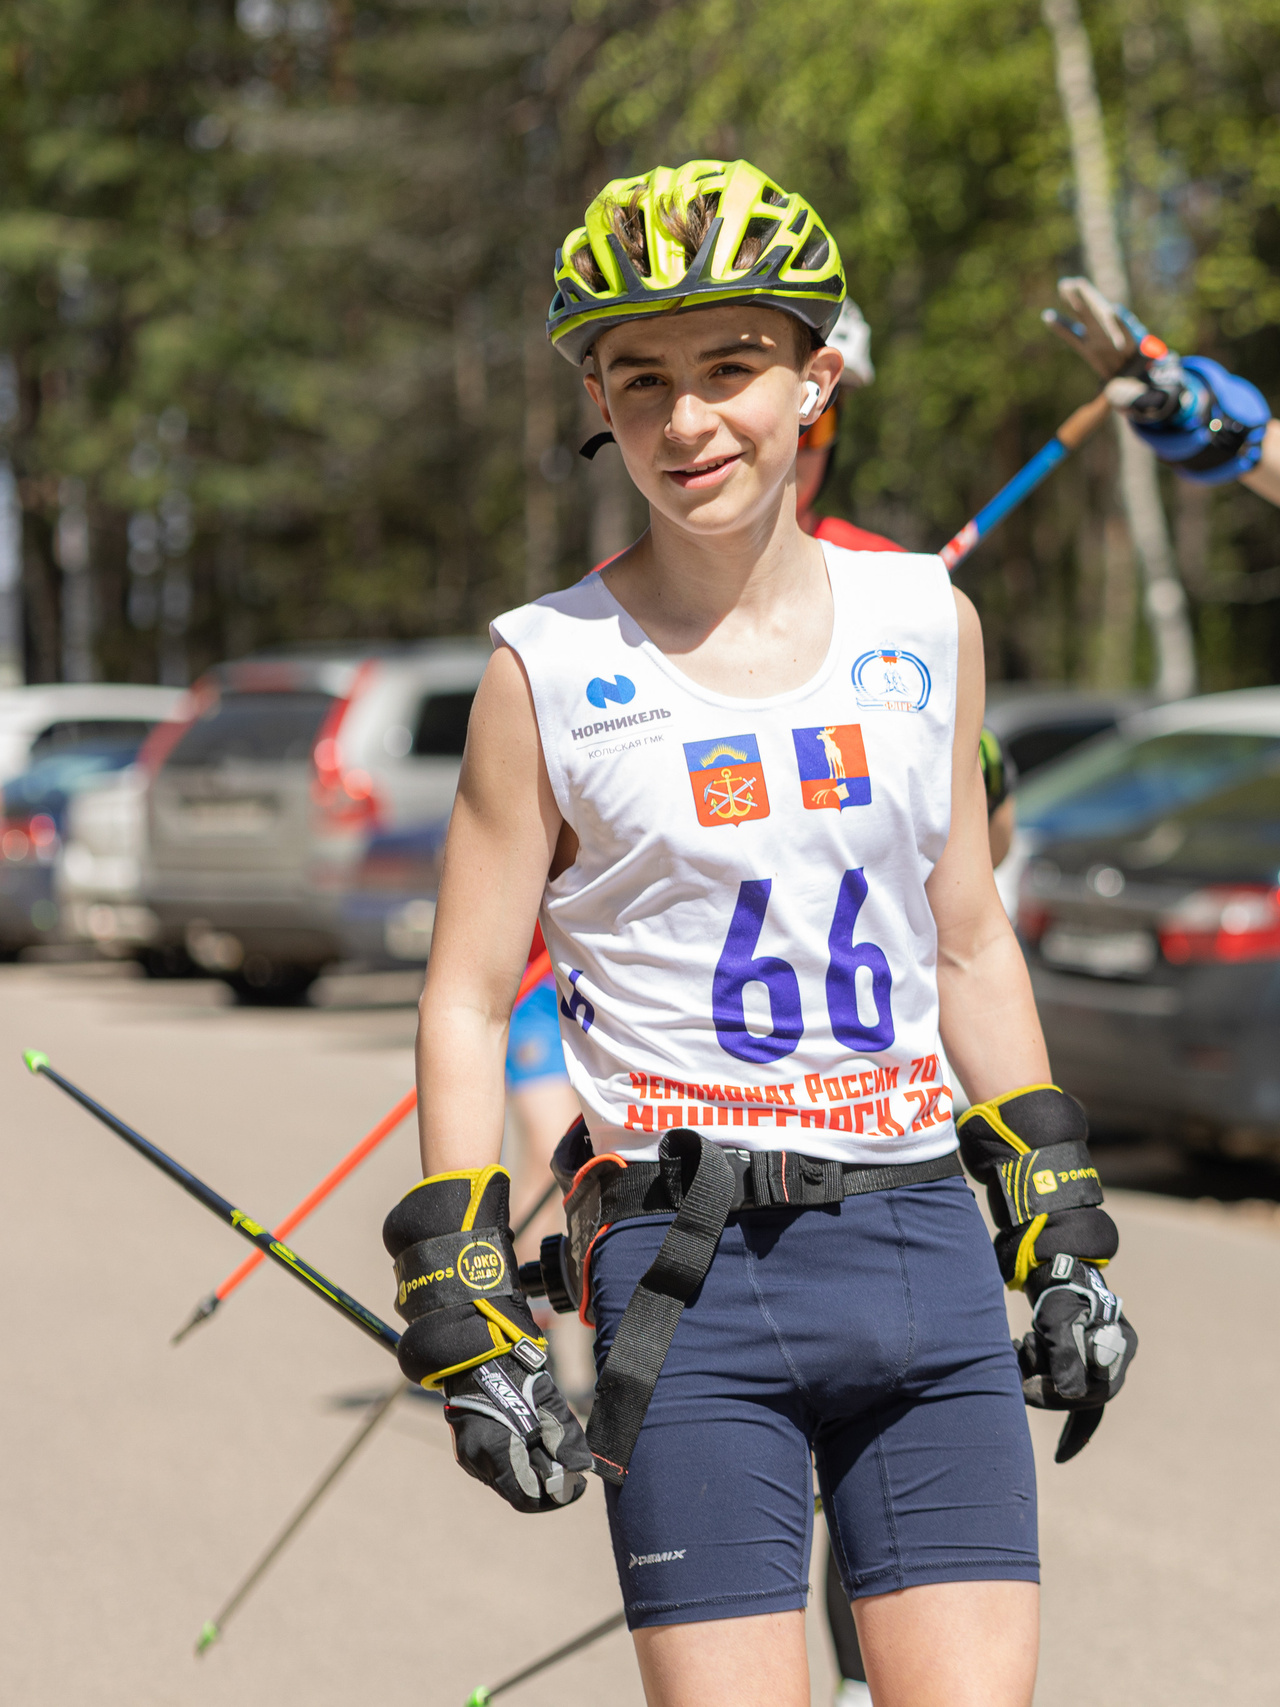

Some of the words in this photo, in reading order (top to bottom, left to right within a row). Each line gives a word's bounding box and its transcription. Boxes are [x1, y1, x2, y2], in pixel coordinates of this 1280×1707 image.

[570, 708, 672, 741] НОРНИКЕЛЬ
[588, 739, 642, 760] КОЛЬСКАЯ
[644, 734, 665, 745] ГМК
[712, 866, 896, 1064] 66
[629, 1071, 796, 1106] ЧЕМПИОНАТ
[406, 1266, 455, 1294] DOMYOS
